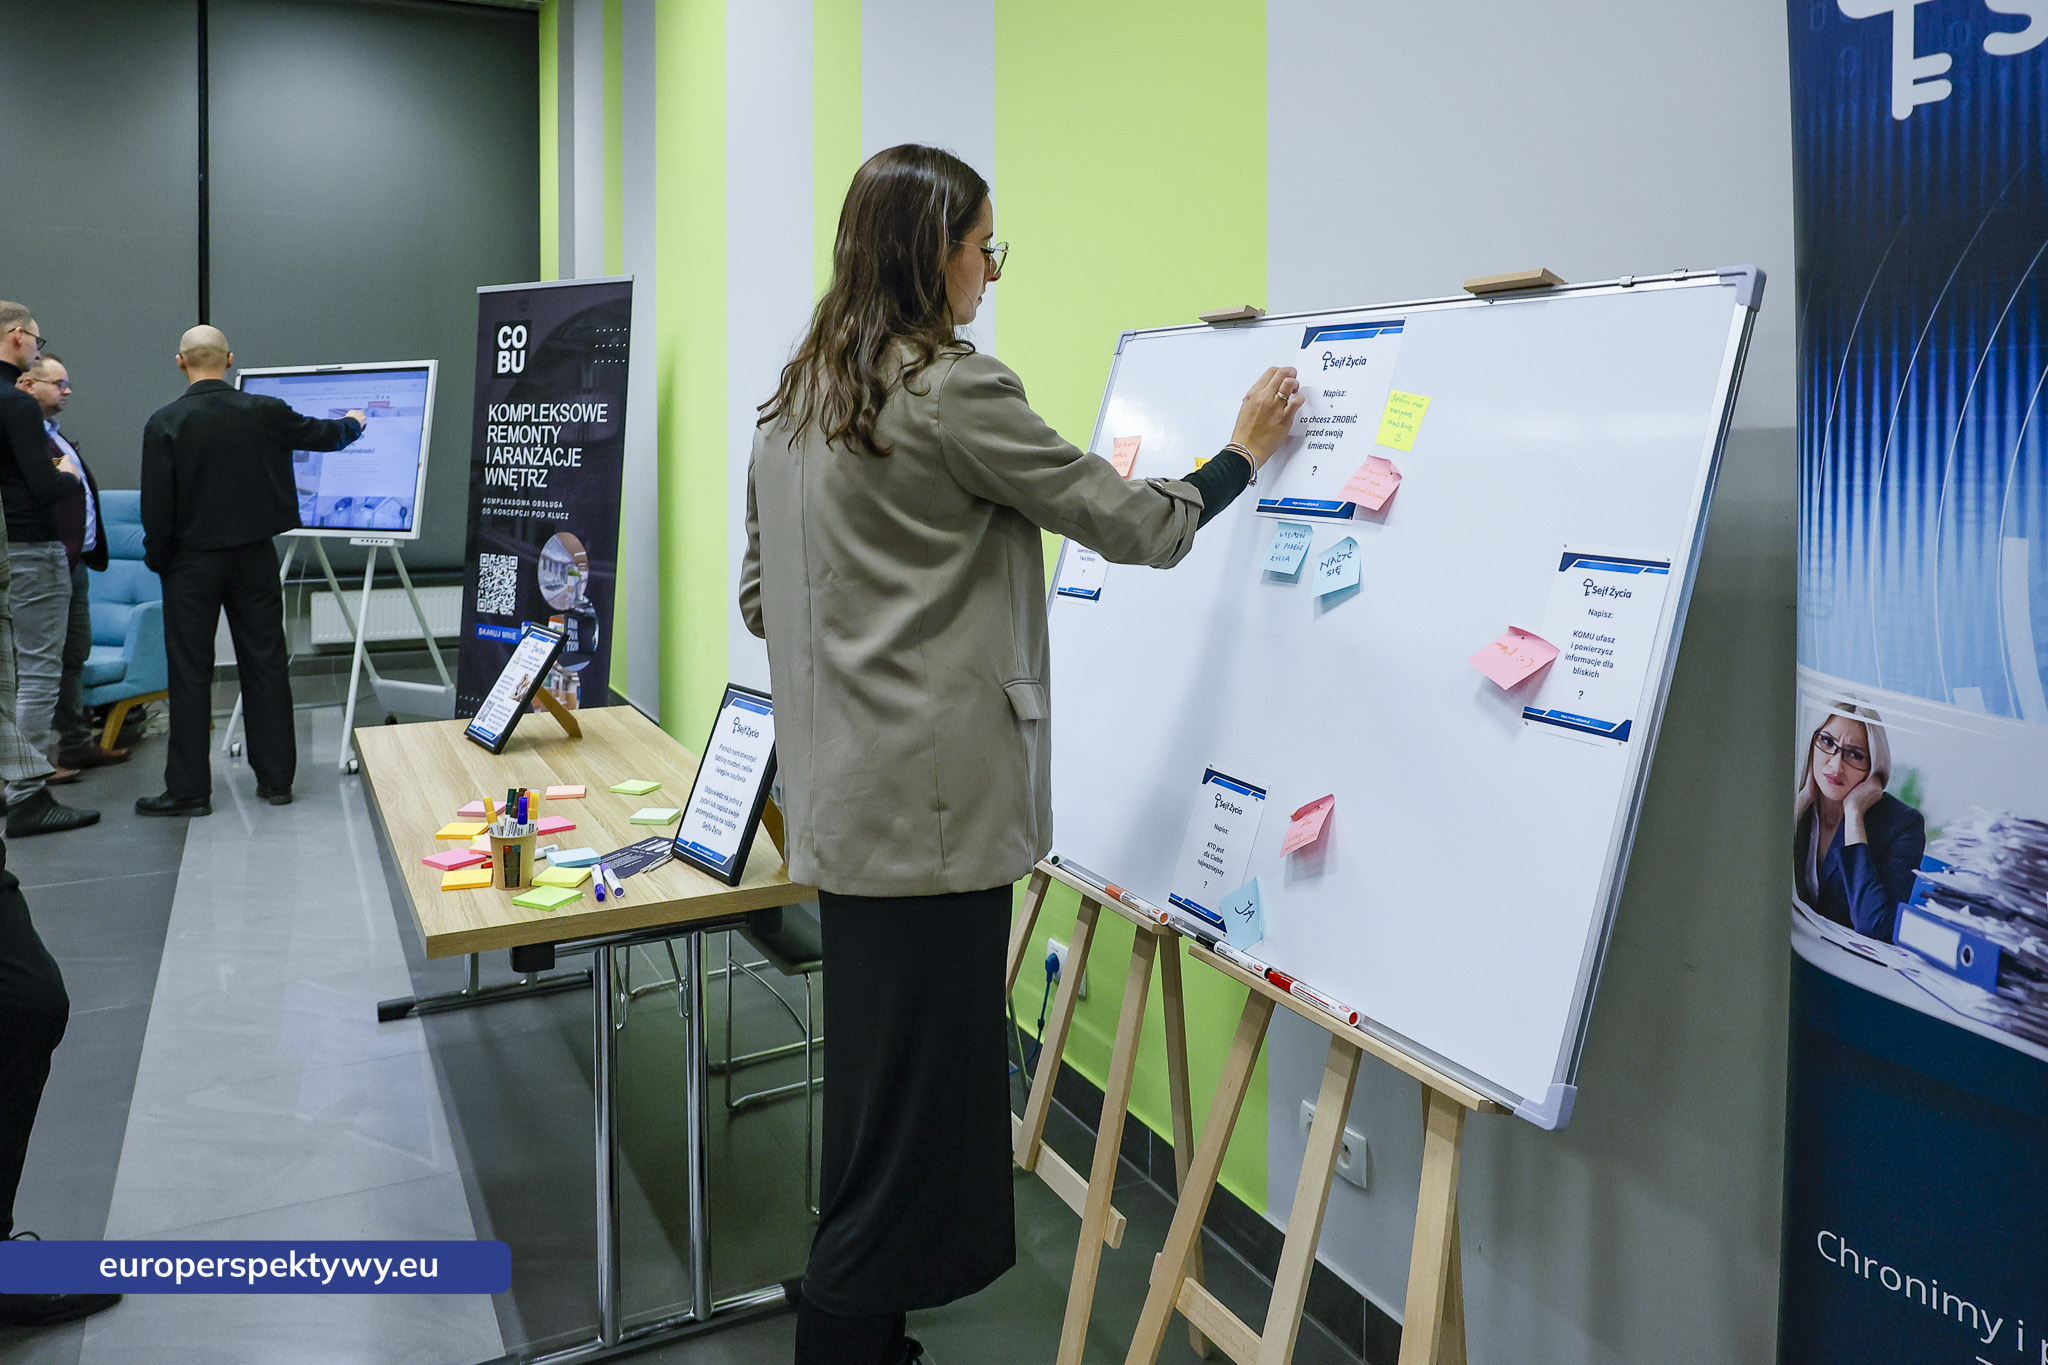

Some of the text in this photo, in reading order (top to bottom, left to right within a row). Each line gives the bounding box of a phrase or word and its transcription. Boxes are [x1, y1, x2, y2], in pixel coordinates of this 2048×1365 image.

[498, 325, 528, 349] CO
[497, 350, 526, 374] BU
[1330, 355, 1367, 368] Sejf Życia
[1323, 389, 1348, 398] Napisz:
[488, 403, 608, 422] KOMPLEKSOWE
[1300, 414, 1358, 424] co chcesz ZROBIĆ
[487, 425, 562, 444] REMONTY
[1305, 428, 1344, 438] przed swoją
[1308, 442, 1334, 451] śmiercią
[485, 444, 582, 467] I ARANŻACJE
[1312, 466, 1318, 476] ?
[484, 467, 548, 491] WNĘTRZ
[482, 498, 564, 508] KOMPLEKSOWA OBSŁUGA
[492, 508, 530, 517] KONCEPCJI
[548, 512, 570, 520] KLUCZ
[1592, 586, 1632, 599] Sejf Życia
[1588, 608, 1614, 620] Napisz:
[1572, 630, 1616, 644] KOMU ufasz
[1574, 643, 1614, 657] powierzysz
[1564, 654, 1614, 669] informacje dla
[1572, 666, 1600, 679] bliskich
[1578, 690, 1584, 700] ?
[1817, 1230, 2024, 1352] Chronimy i
